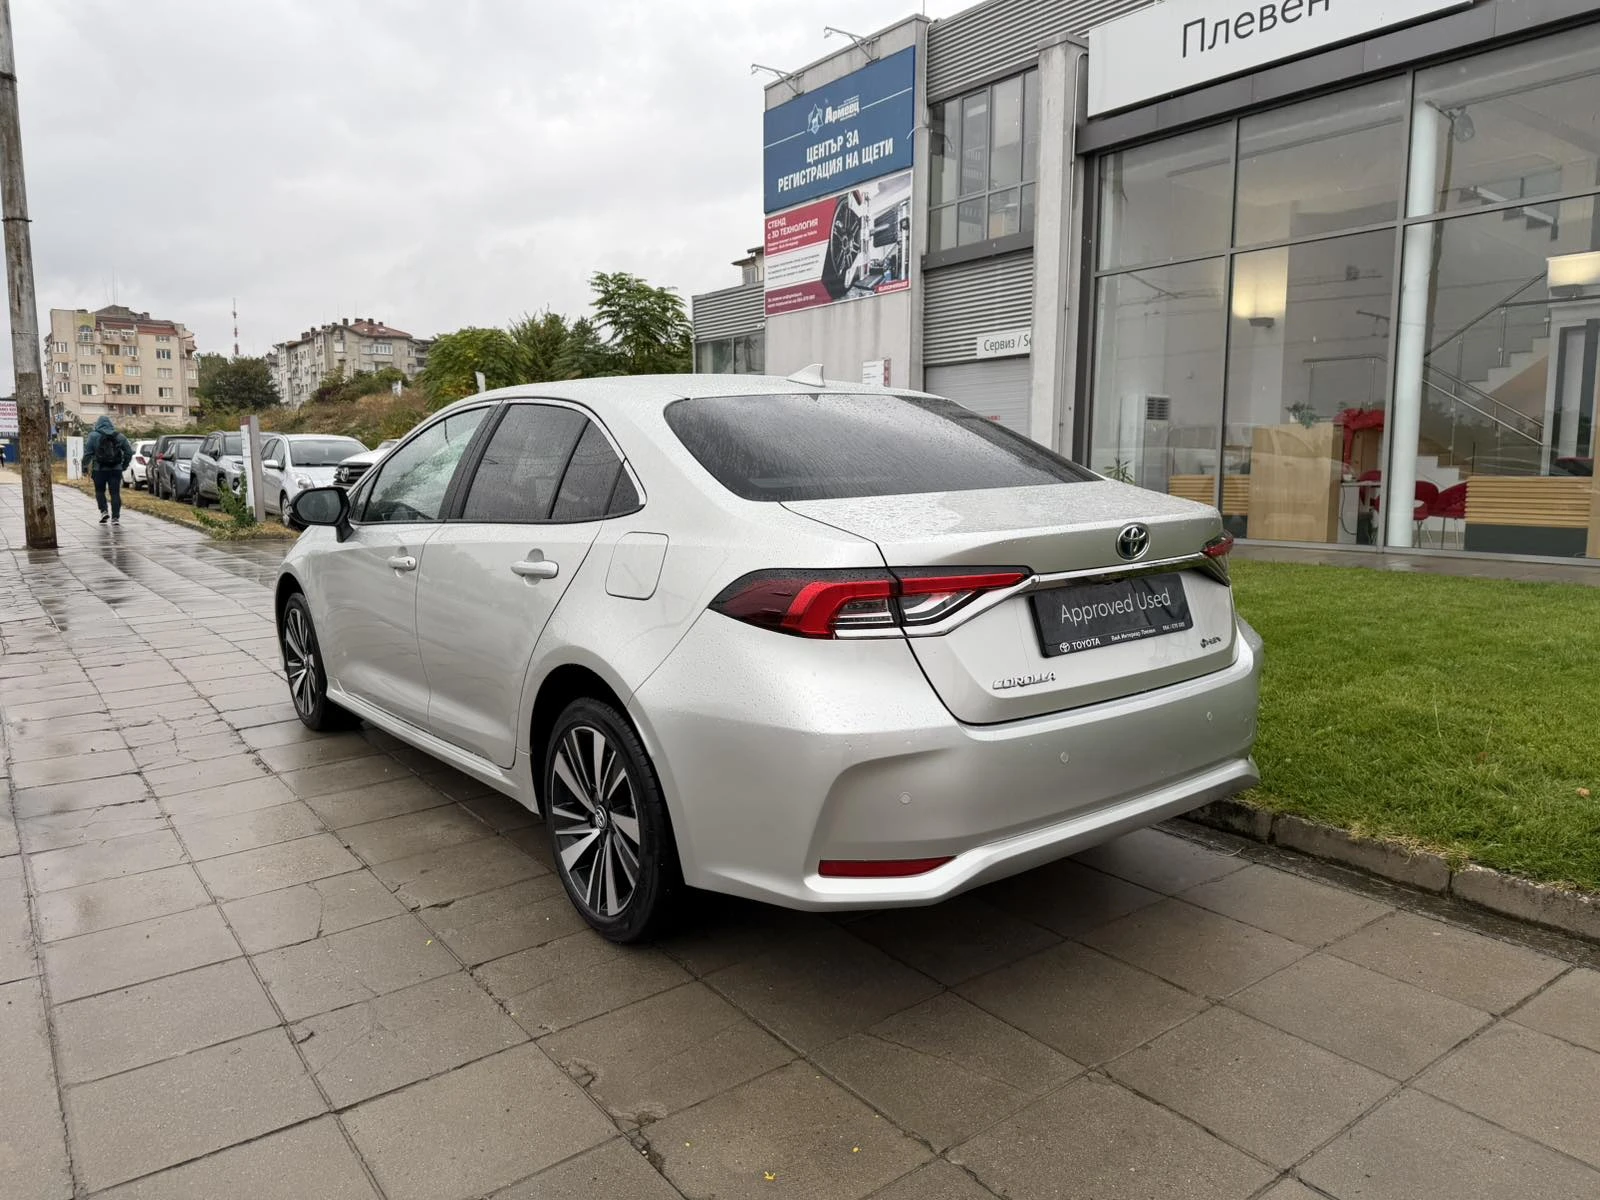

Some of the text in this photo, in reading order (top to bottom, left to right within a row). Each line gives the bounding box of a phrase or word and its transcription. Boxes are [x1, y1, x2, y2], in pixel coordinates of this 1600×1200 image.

[1183, 0, 1330, 58] Плевен
[806, 129, 860, 163] ЦЕНТЪР ЗА
[777, 137, 894, 193] РЕГИСТРАЦИЯ НА ЩЕТИ
[767, 217, 786, 230] СТЕНД
[984, 339, 1015, 353] Сервиз
[1060, 588, 1171, 627] Approved Used
[1071, 637, 1101, 651] TOYOTA
[992, 672, 1056, 690] COROLLA
